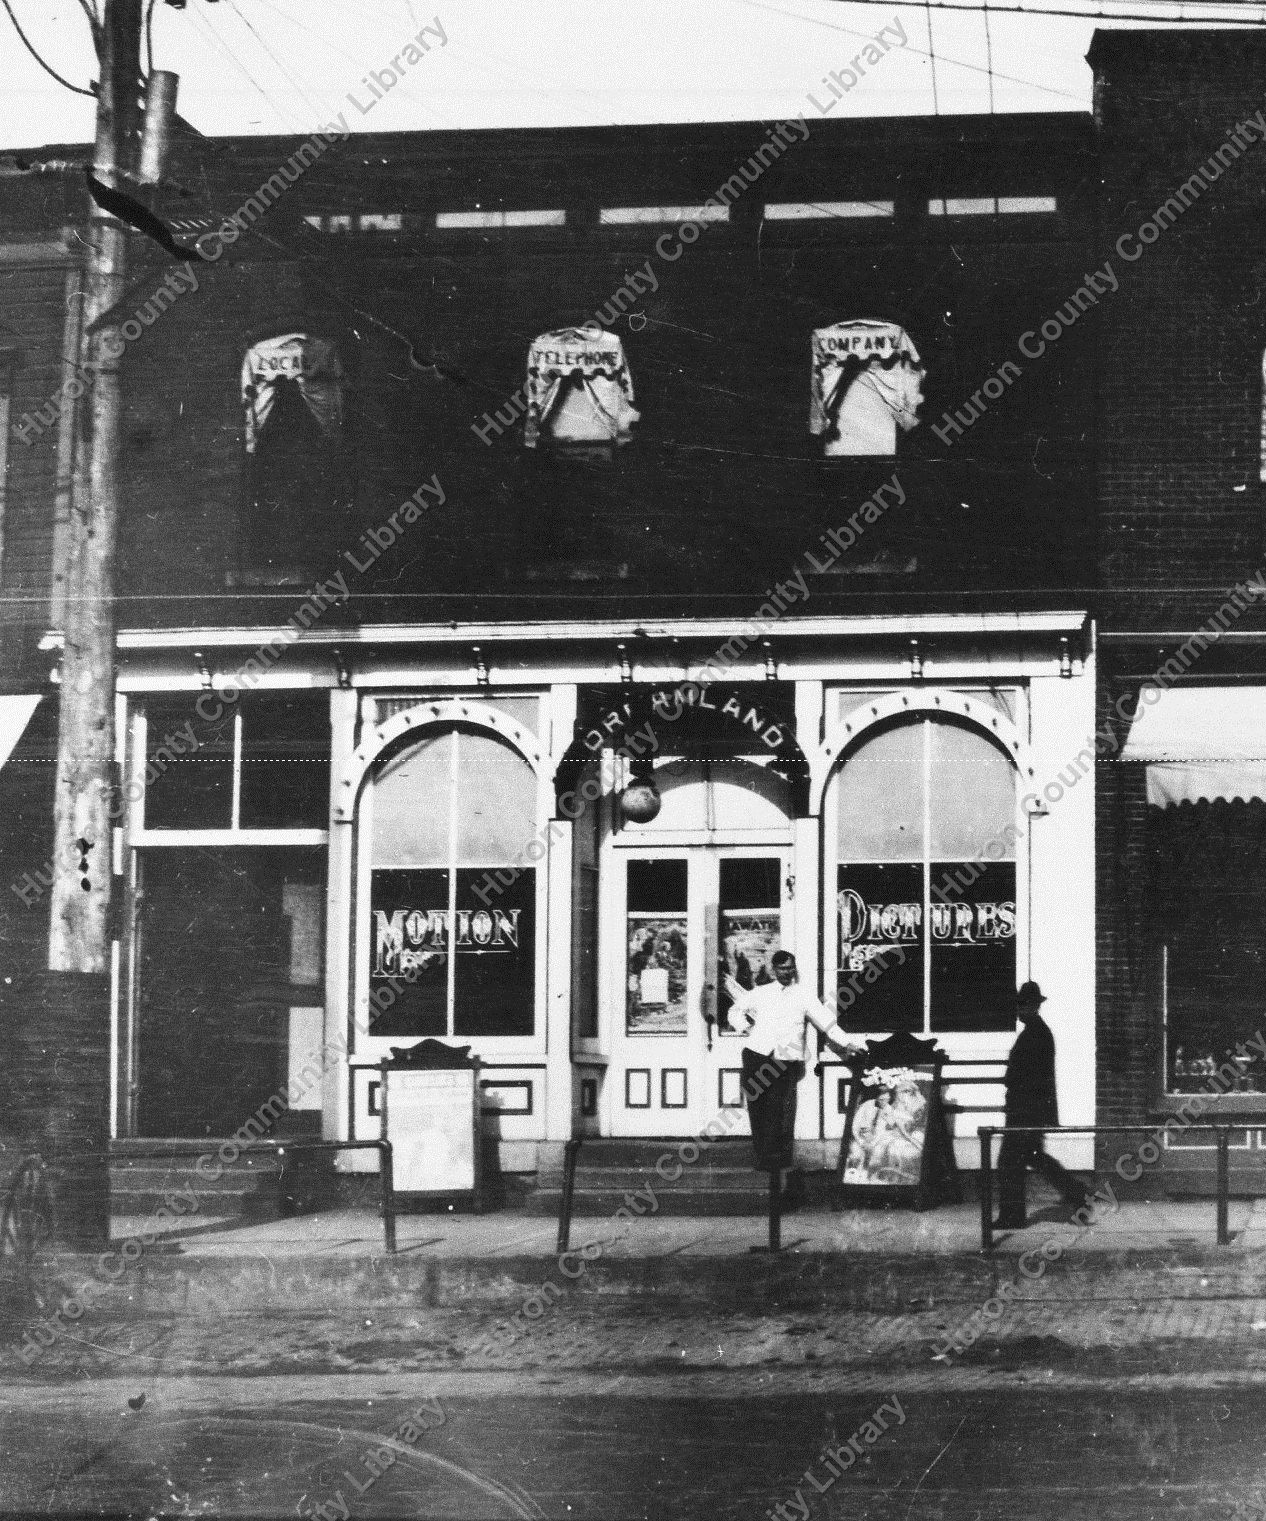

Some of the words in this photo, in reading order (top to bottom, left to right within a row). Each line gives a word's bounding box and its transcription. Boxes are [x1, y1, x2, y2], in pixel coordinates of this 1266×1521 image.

[532, 350, 620, 368] TELEPHONE
[818, 335, 901, 353] COMPANY
[372, 908, 522, 978] MOTION
[837, 888, 1018, 972] PICTURES
